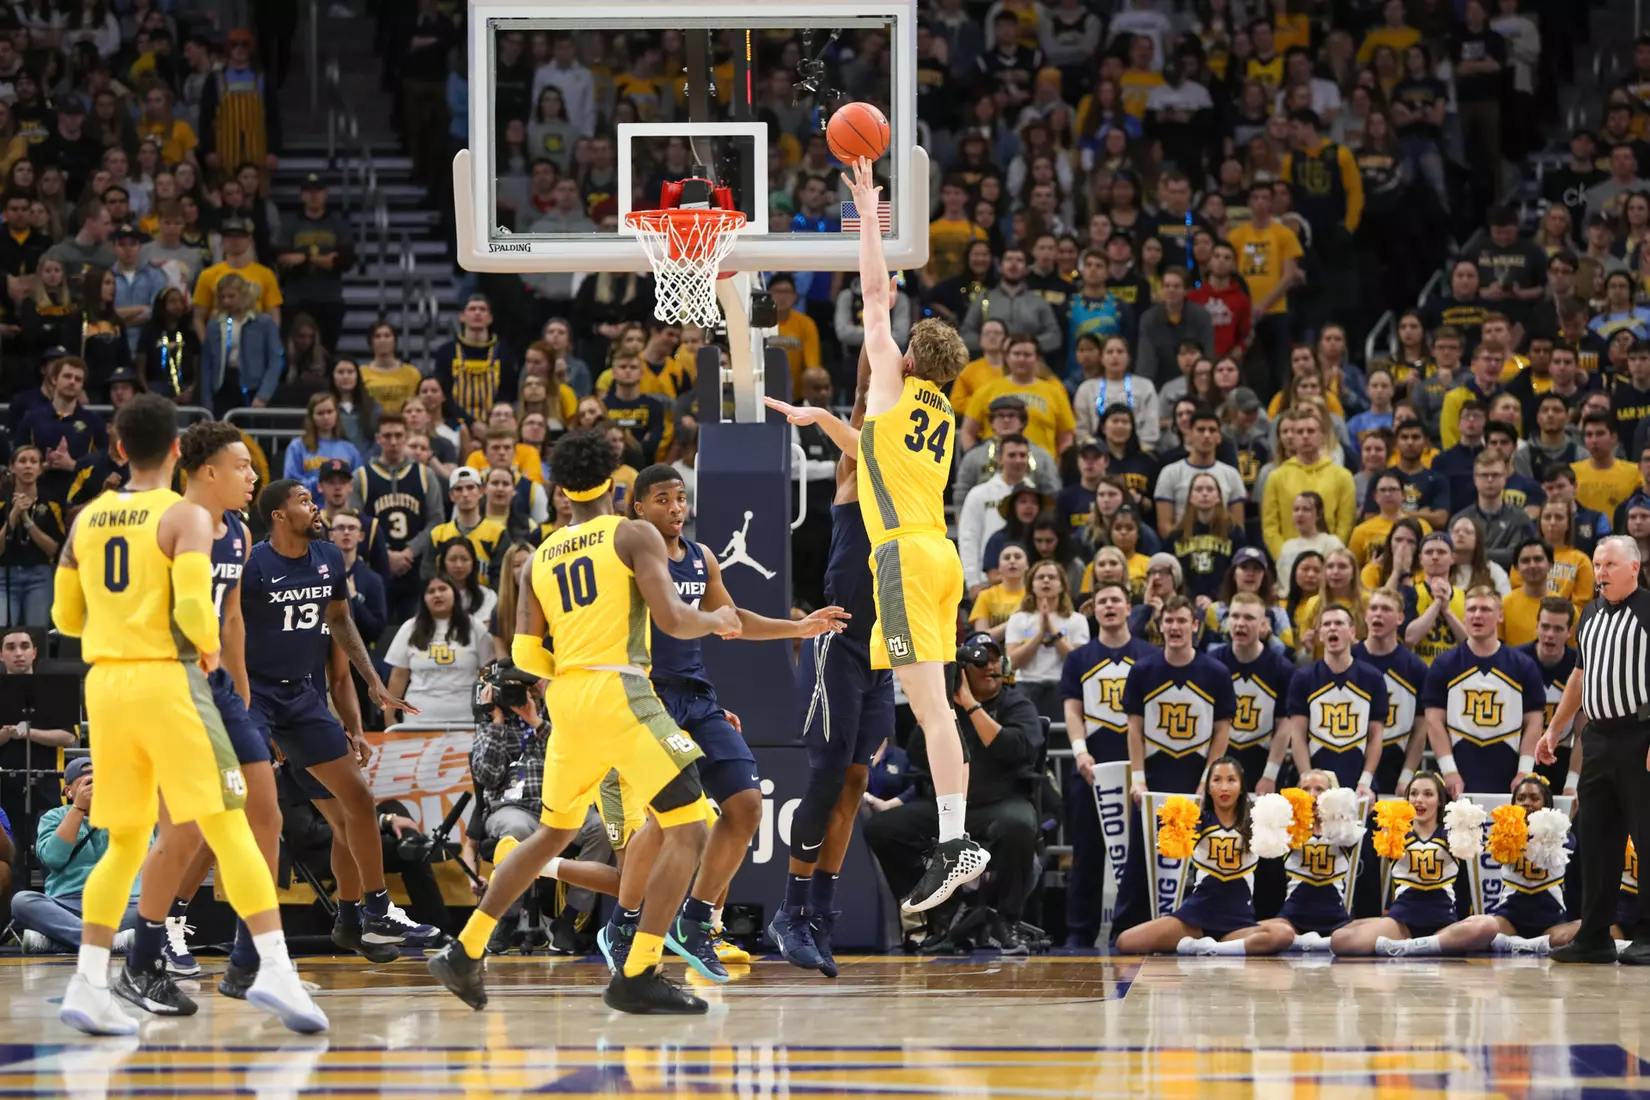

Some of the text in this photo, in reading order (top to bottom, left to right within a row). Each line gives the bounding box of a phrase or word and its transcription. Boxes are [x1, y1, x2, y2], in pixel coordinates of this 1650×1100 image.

[488, 242, 532, 254] SPALDING
[904, 408, 950, 464] 34
[88, 509, 149, 528] HOWARD
[389, 512, 408, 540] 3
[542, 530, 605, 563] TORRENCE
[104, 536, 130, 593] 0
[211, 563, 243, 579] VIER
[268, 585, 333, 604] XAVIER
[552, 556, 598, 613] 10
[674, 581, 707, 595] VIER
[282, 603, 320, 631] 13
[429, 643, 456, 666] MU
[886, 634, 911, 658] MU
[1156, 701, 1199, 741] MU
[1319, 700, 1359, 739] MU
[1462, 689, 1505, 728] MU
[663, 732, 697, 754] MU
[224, 769, 246, 797] MU
[1095, 784, 1125, 837] OUT
[605, 822, 620, 842] MU
[1207, 836, 1243, 871] MU
[1301, 843, 1337, 877] MU
[1408, 848, 1445, 881] MU
